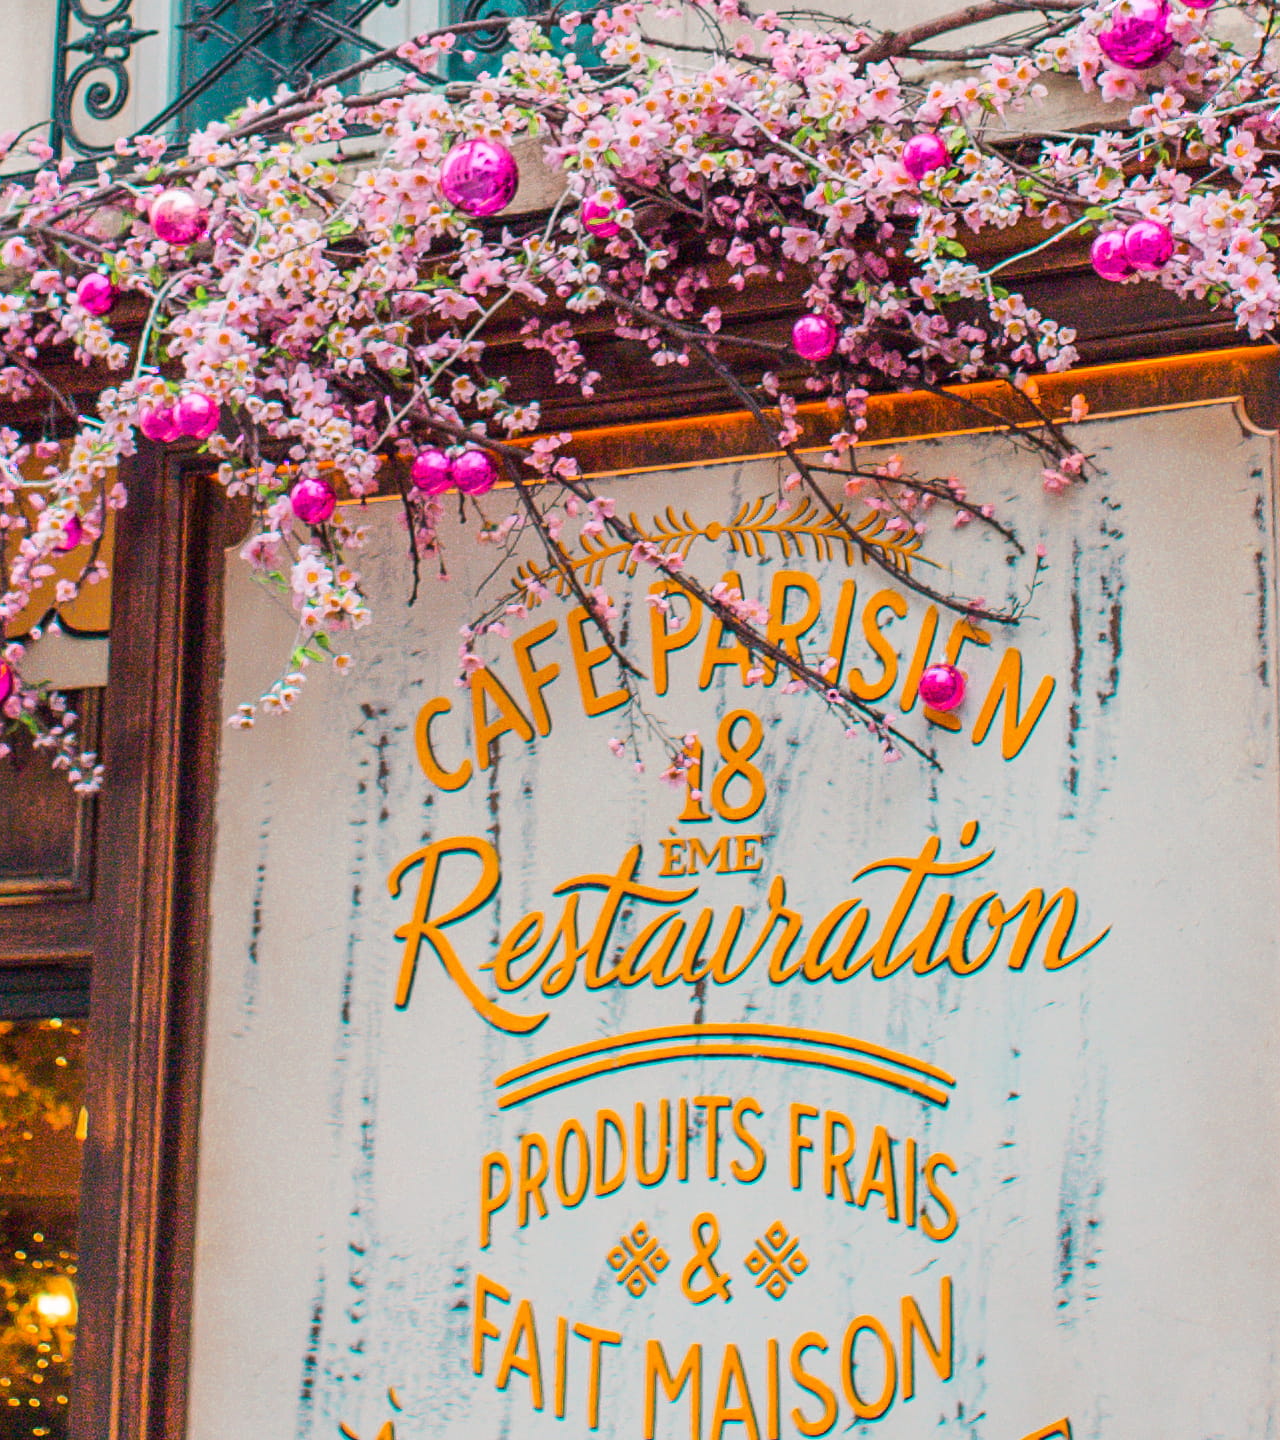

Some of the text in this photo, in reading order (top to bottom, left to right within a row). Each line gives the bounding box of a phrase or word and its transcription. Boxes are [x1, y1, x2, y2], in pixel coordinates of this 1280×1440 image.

[649, 569, 1056, 761] PARISIEN
[677, 708, 768, 823] 18
[387, 820, 1110, 1036] Restauration
[479, 1095, 960, 1251] PRODUITS FRAIS
[680, 1211, 733, 1304] &
[472, 1272, 624, 1431] FAIT
